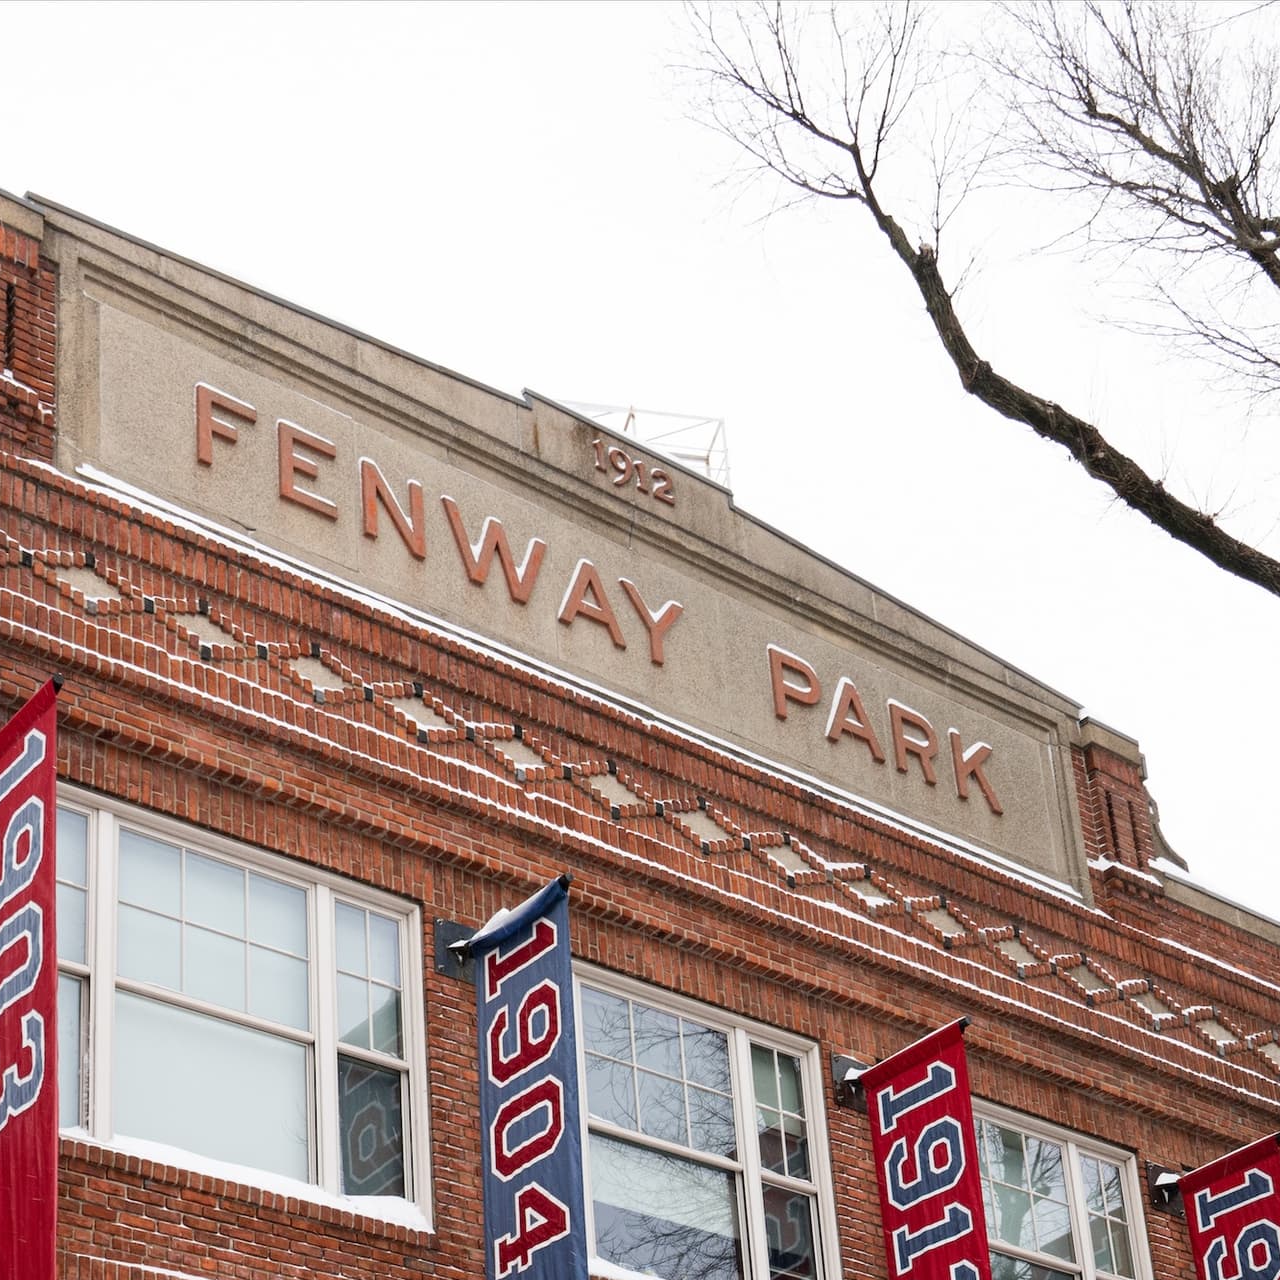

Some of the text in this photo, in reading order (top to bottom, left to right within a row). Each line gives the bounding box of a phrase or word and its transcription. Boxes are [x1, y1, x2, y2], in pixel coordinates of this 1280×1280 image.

[195, 381, 1003, 815] FENWAY PARK
[592, 439, 675, 508] 1912
[485, 916, 571, 1280] 1904
